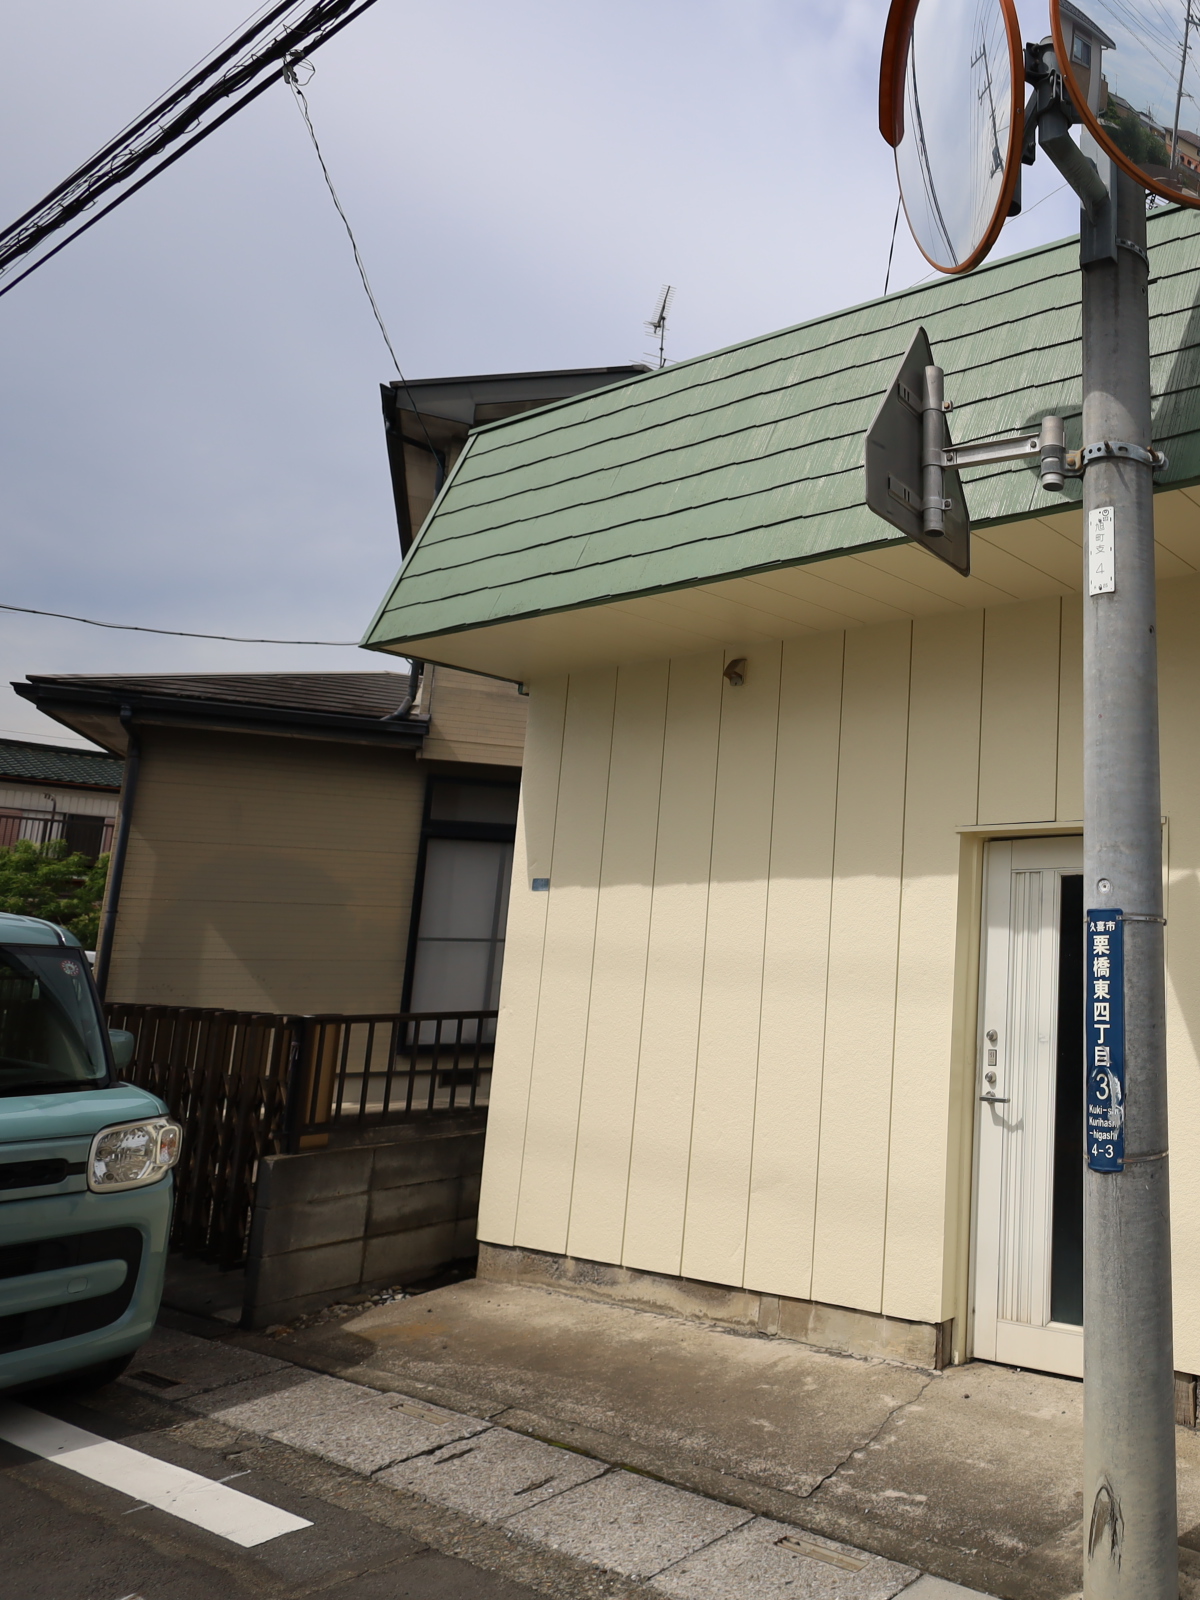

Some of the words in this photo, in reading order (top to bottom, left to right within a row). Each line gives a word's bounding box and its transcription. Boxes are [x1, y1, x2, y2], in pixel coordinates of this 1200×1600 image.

[1089, 920, 1116, 932] 久喜市
[1093, 934, 1111, 1067] 栗橋東四丁目
[1096, 1073, 1110, 1100] 3
[1091, 1143, 1114, 1158] 4-3
